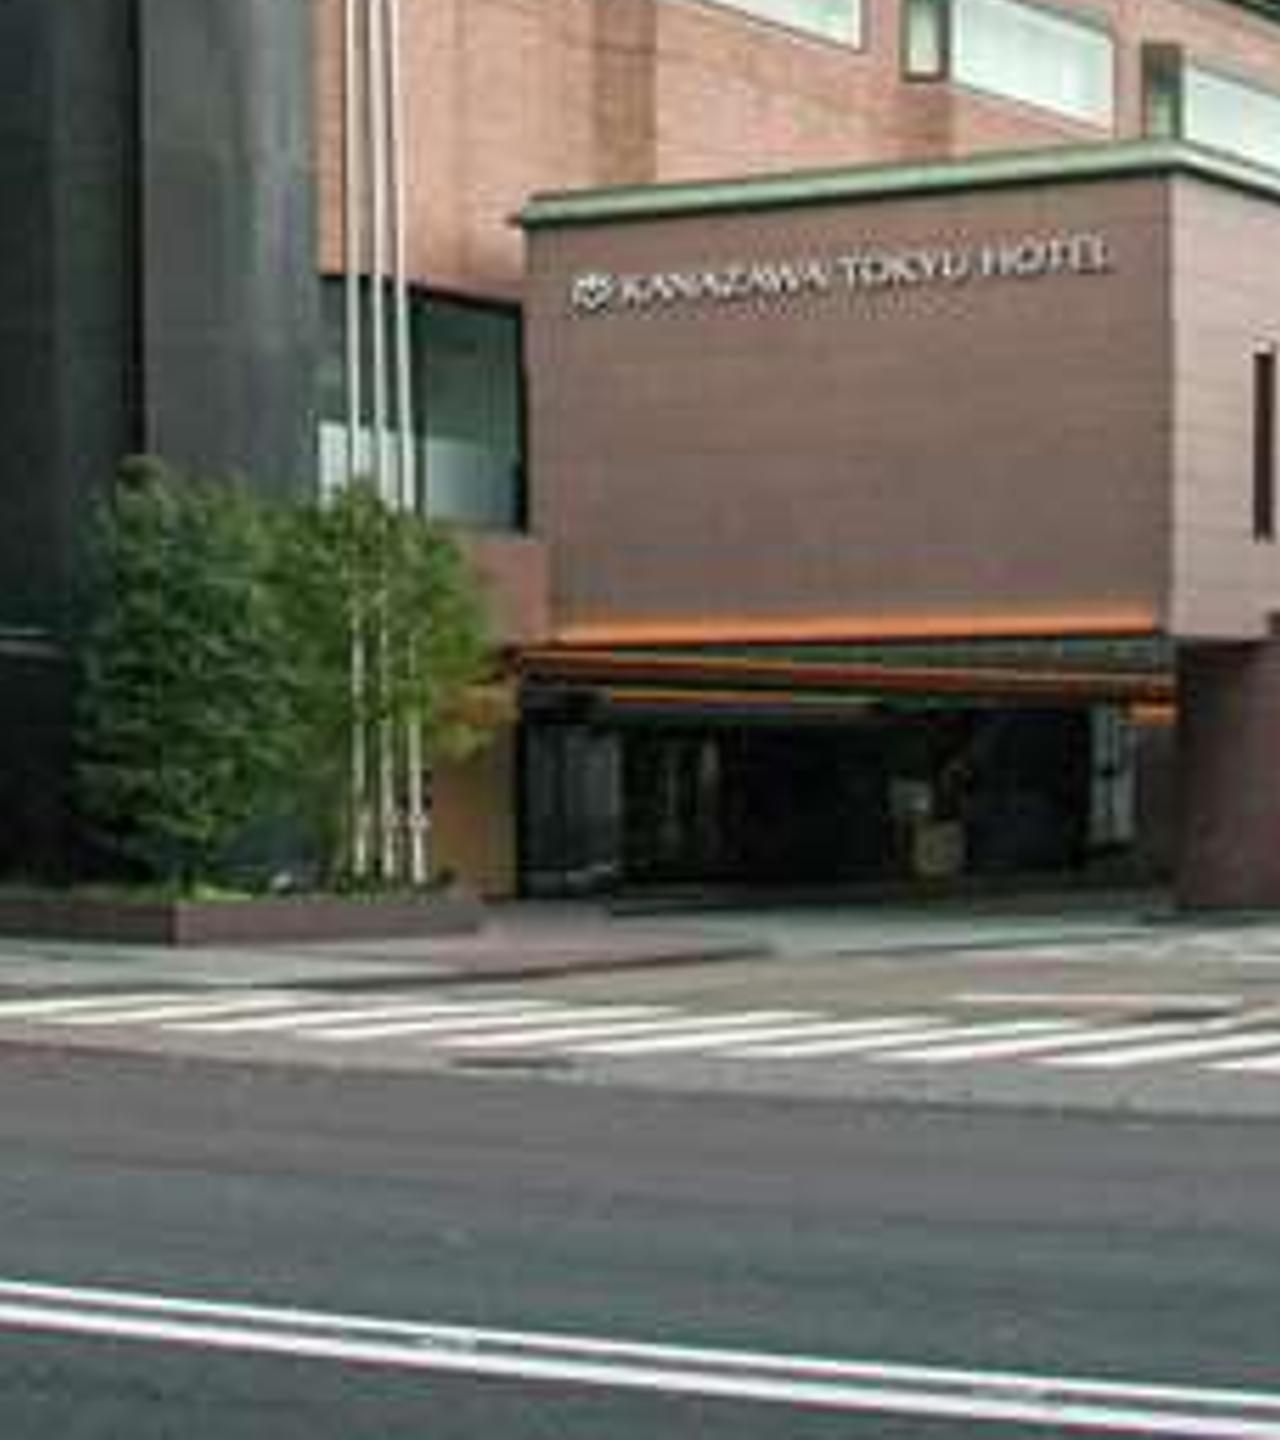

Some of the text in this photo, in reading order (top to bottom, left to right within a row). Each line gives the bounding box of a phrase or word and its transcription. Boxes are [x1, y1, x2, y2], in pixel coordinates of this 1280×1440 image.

[622, 231, 1113, 306] KANAZAWA TOKYU HOTEL
